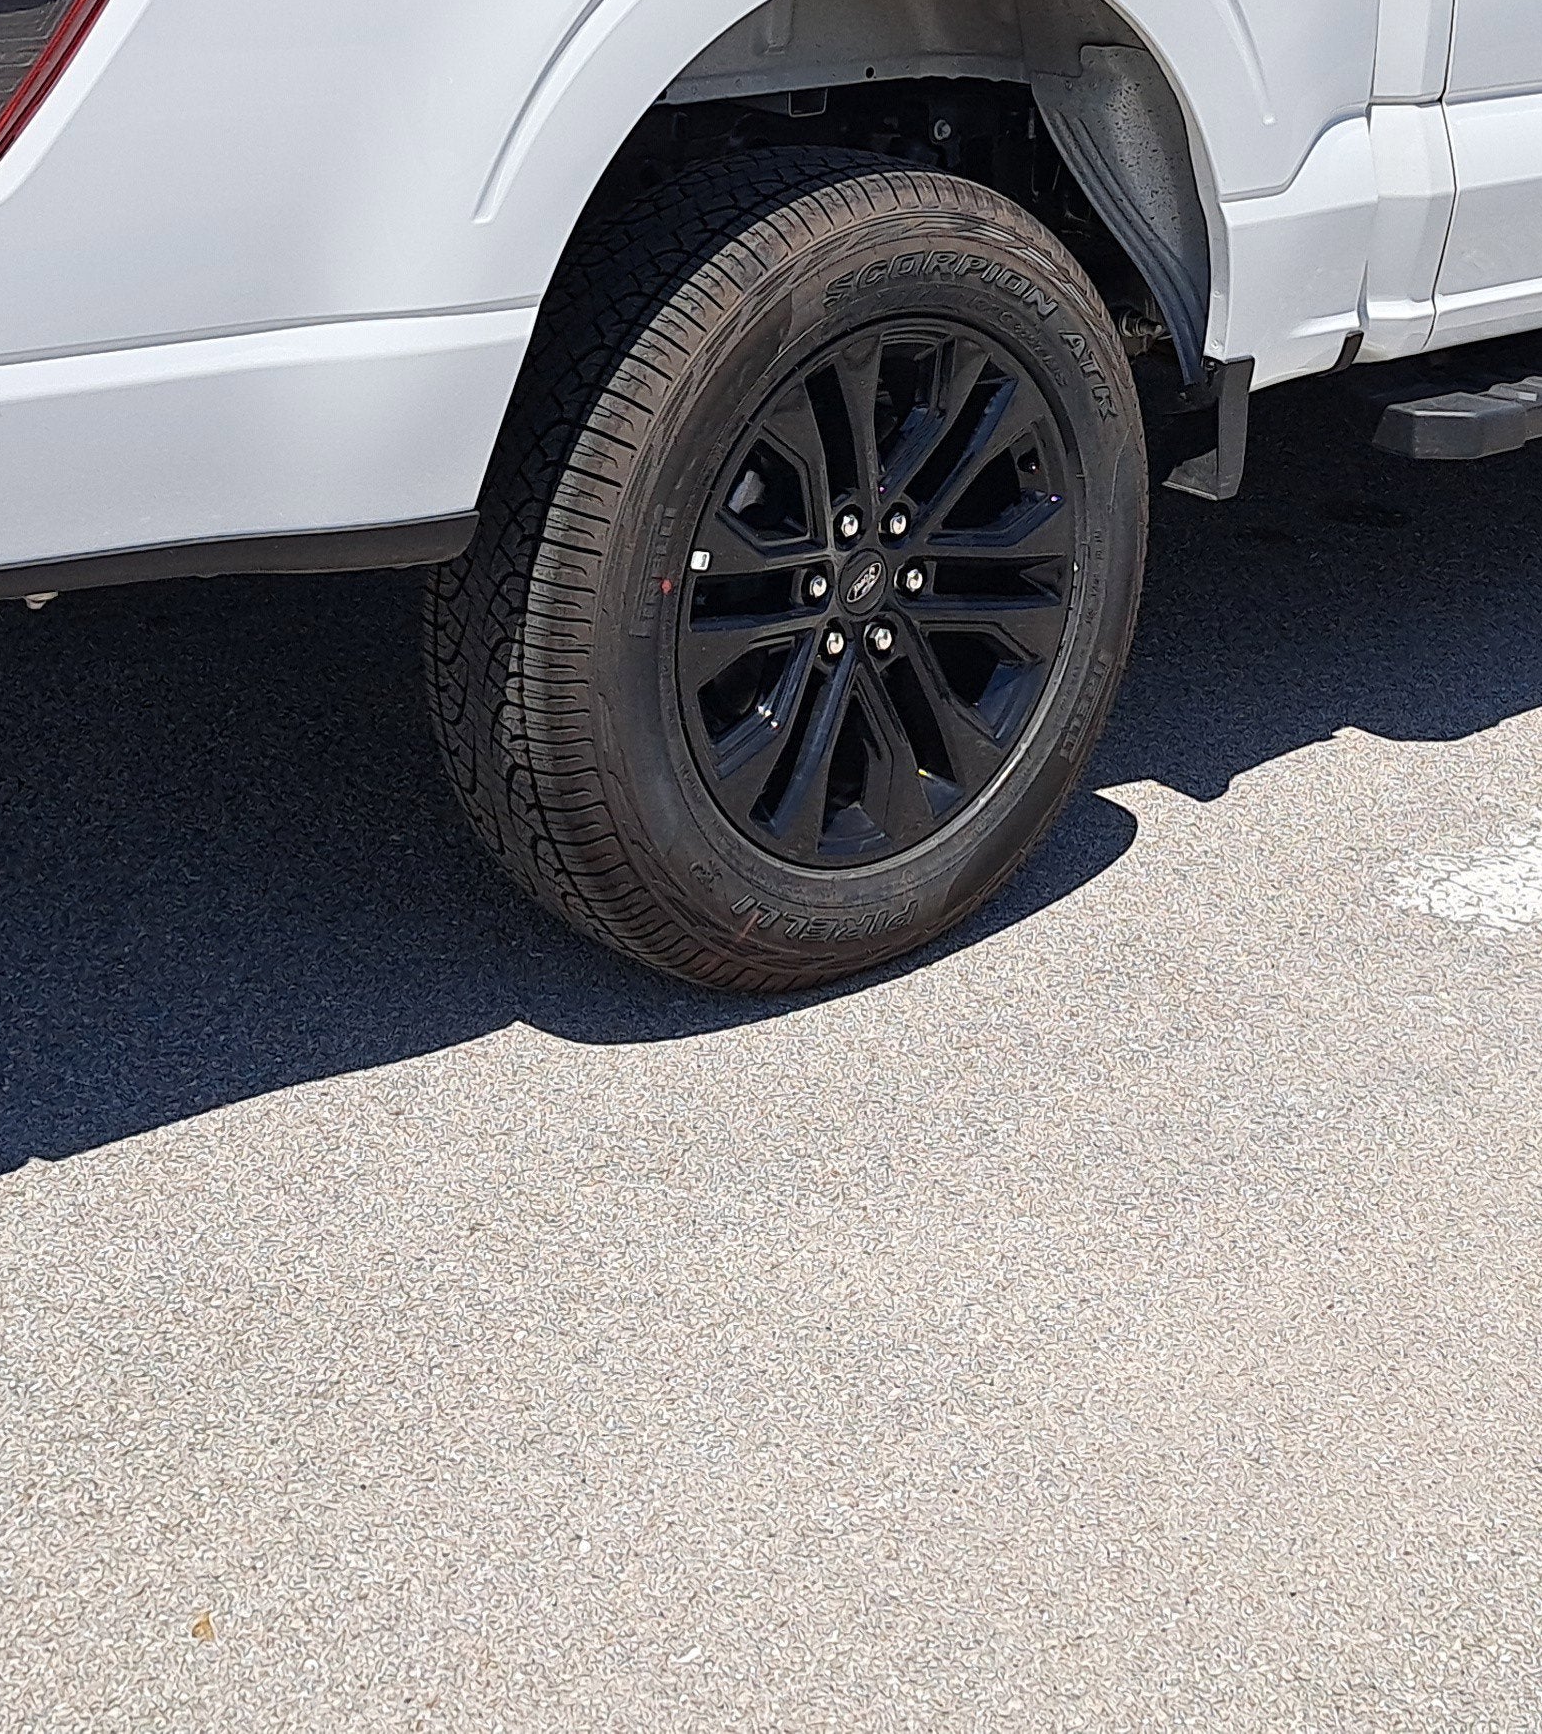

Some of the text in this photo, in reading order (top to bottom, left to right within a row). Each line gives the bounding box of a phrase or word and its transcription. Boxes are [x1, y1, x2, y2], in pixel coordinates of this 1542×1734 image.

[822, 250, 1058, 317] SCORPION
[1058, 330, 1118, 421] ATK
[730, 893, 919, 943] PIRELLI
